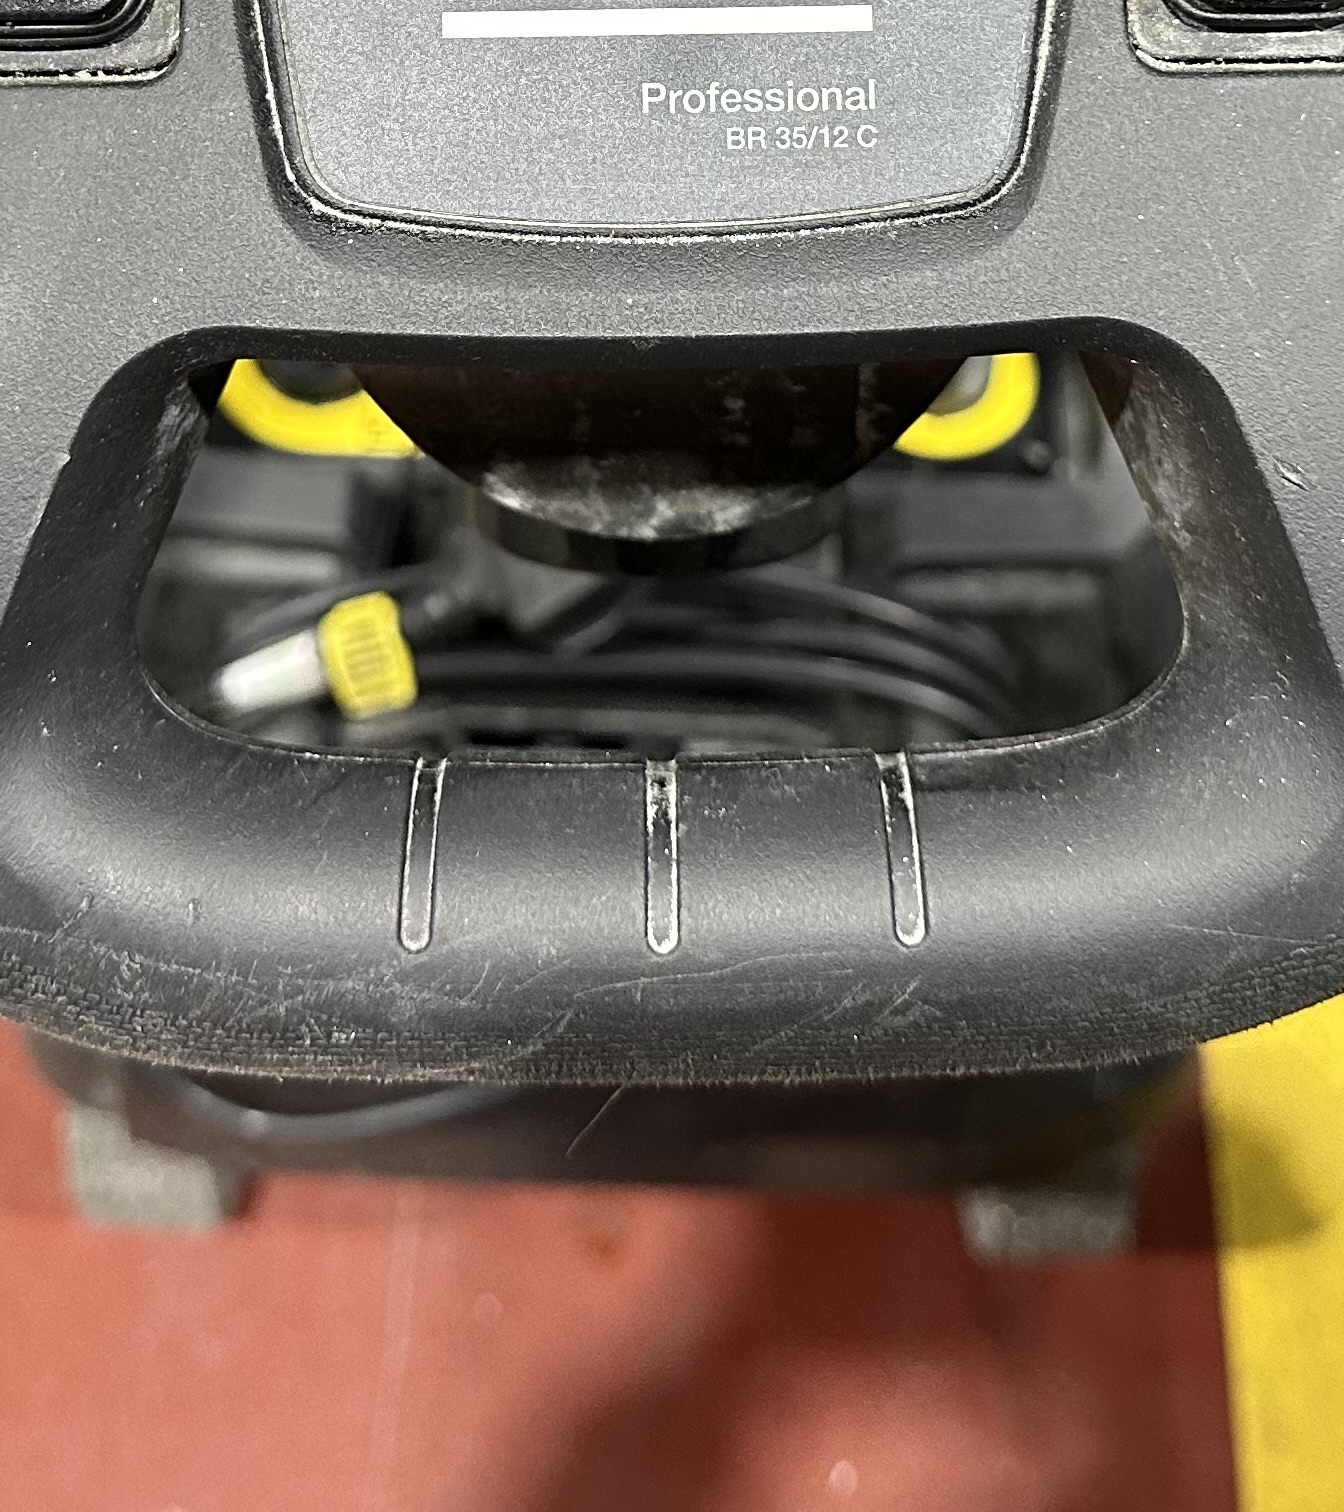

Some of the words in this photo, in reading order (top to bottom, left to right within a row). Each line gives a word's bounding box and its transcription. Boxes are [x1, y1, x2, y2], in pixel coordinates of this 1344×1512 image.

[641, 79, 876, 114] Professional
[726, 128, 766, 149] BR
[775, 125, 849, 149] 35/12
[856, 125, 878, 148] C
